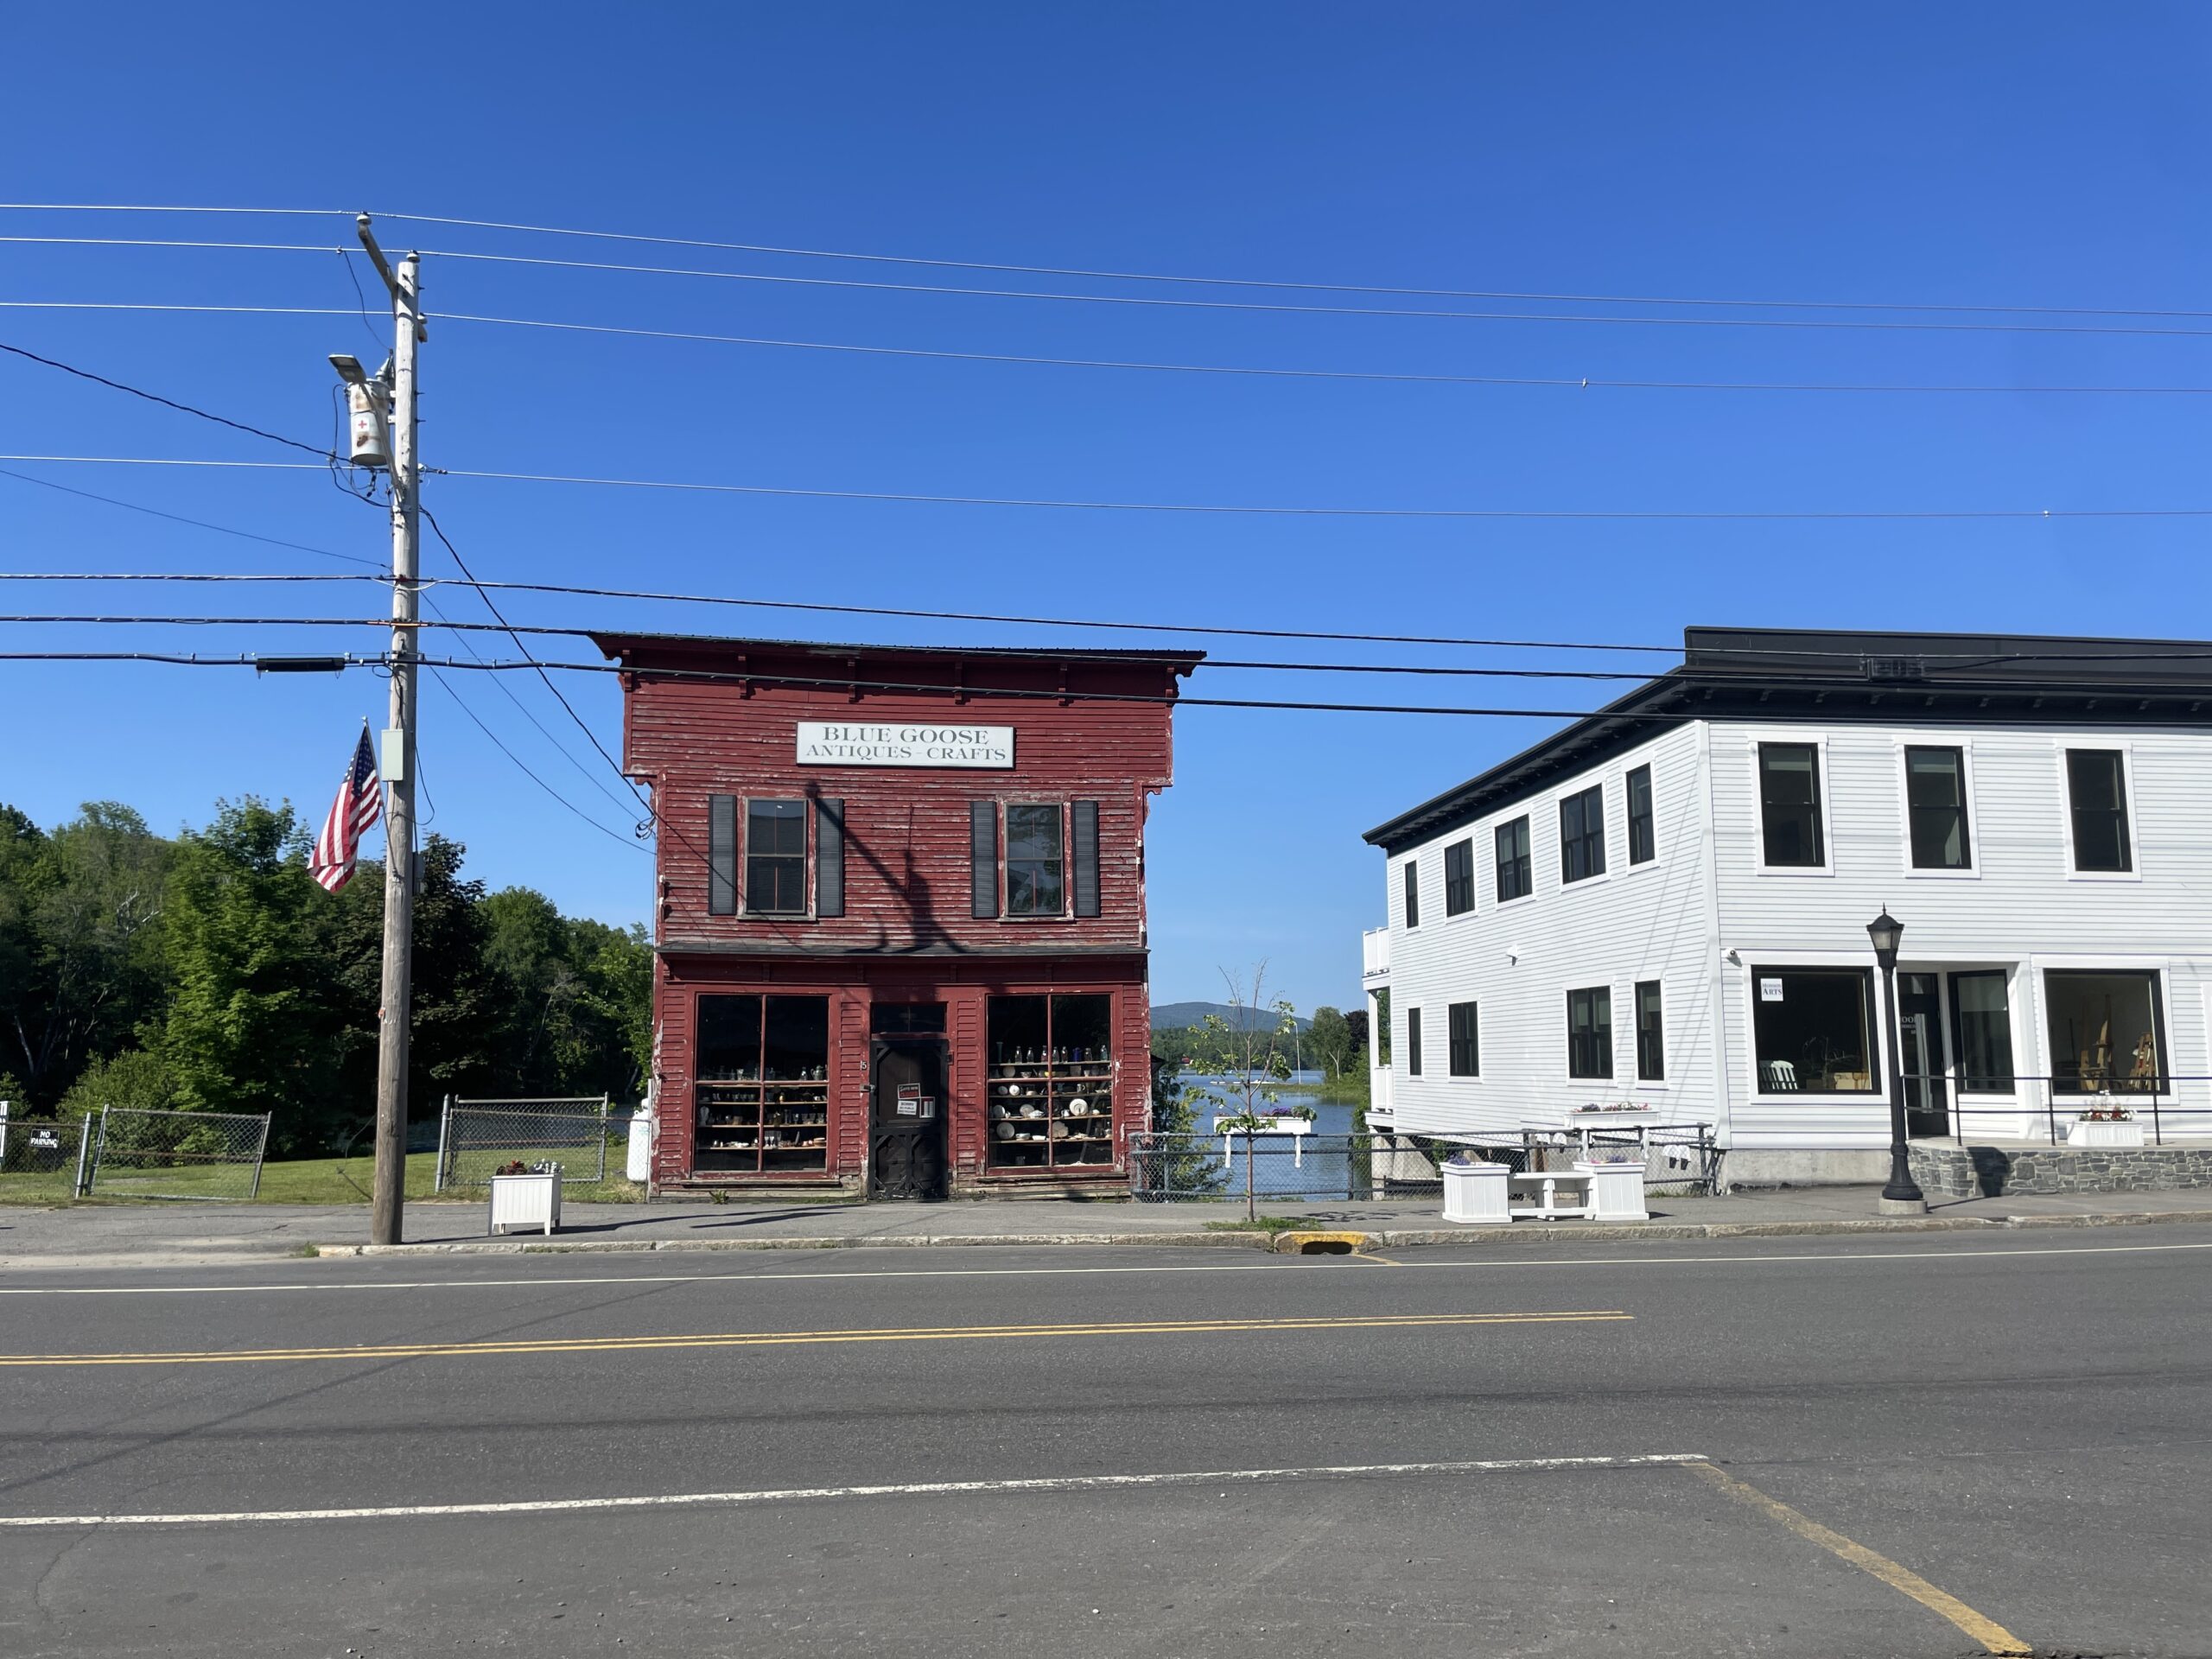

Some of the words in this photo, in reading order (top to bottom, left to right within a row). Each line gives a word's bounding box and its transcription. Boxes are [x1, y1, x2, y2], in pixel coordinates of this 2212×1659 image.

[823, 727, 892, 742] BLUE
[899, 728, 989, 745] GOOSE
[806, 745, 912, 760] ANTIQUES
[927, 747, 1006, 760] CRAFTS
[30, 1137, 57, 1146] PARKING
